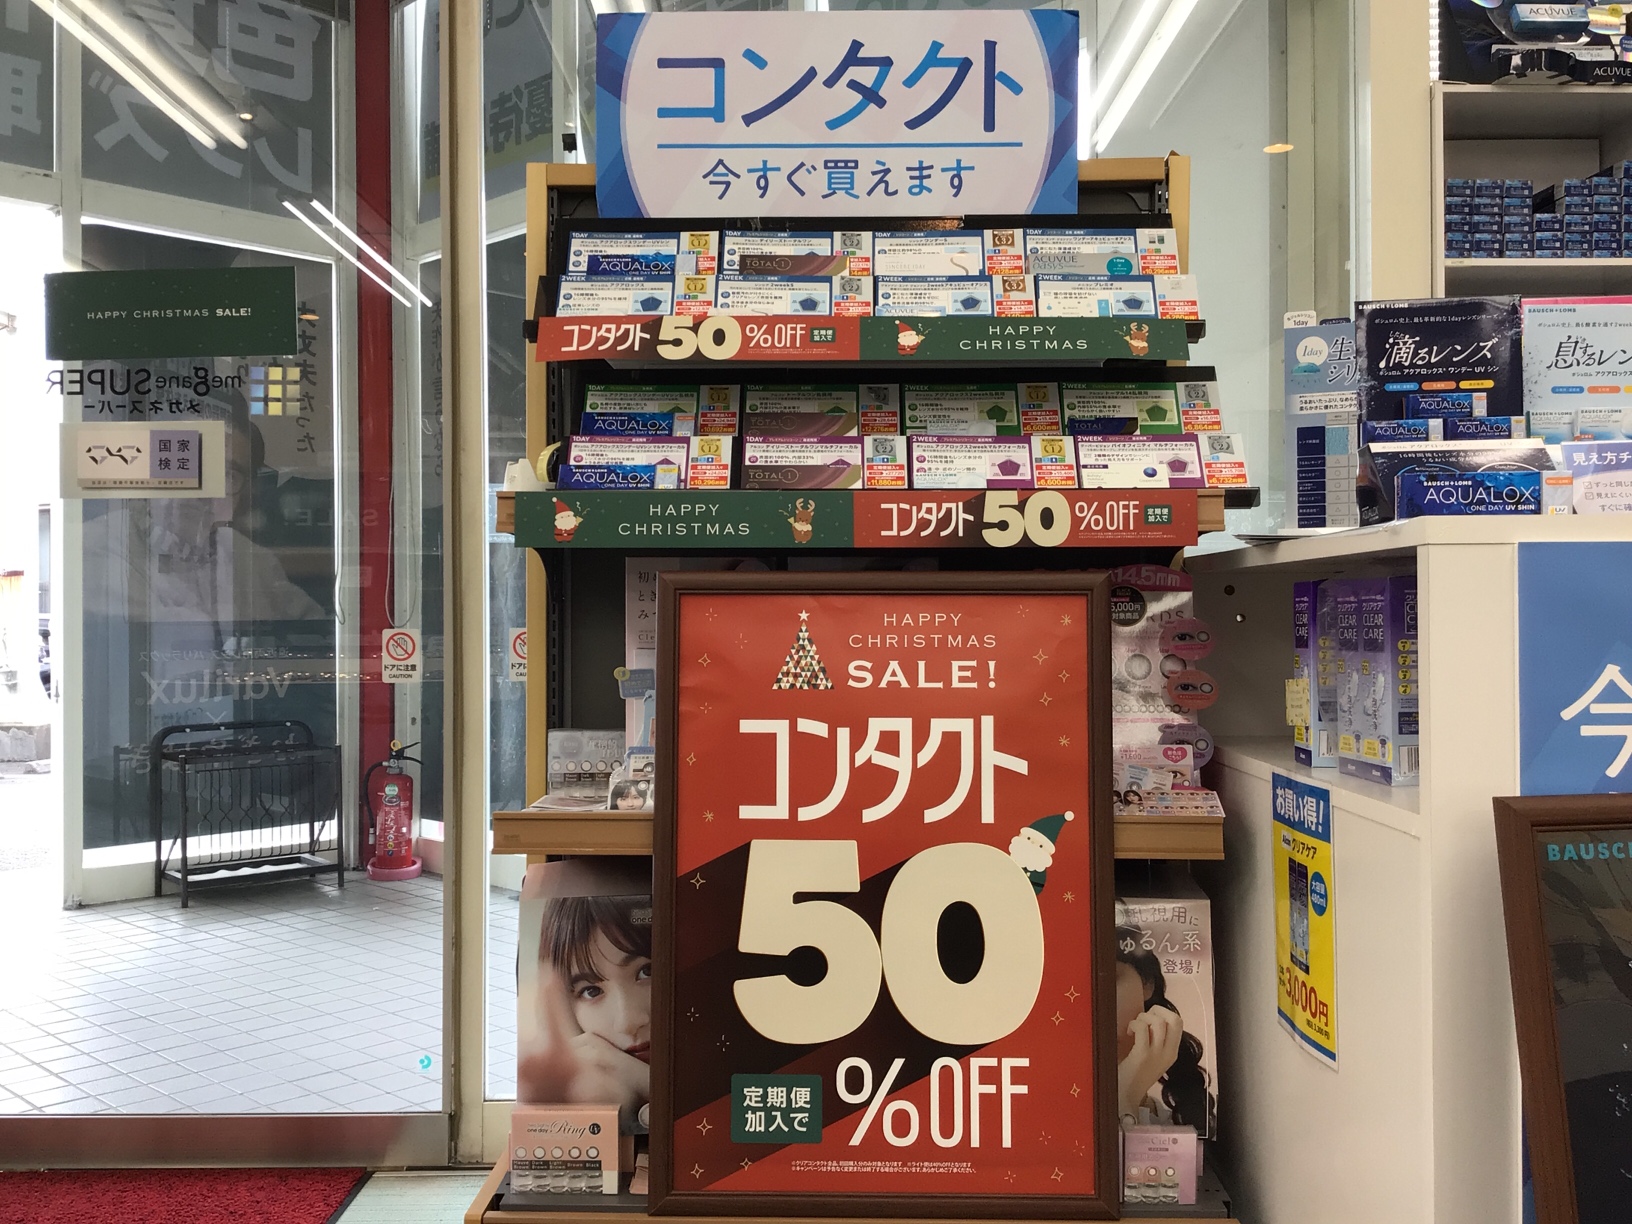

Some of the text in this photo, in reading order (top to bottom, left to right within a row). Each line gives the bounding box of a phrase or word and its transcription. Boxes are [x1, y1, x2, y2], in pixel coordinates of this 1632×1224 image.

[1529, 7, 1578, 16] ACUVUE
[1593, 66, 1632, 76] ACUVUE
[657, 39, 1023, 132] コンタクト
[702, 158, 976, 199] 今すぐ買えます
[1032, 255, 1078, 263] ACUVUE
[598, 261, 673, 271] AQUALOX
[87, 307, 252, 319] HAPPY CHRISTMAS SALE!
[989, 325, 1057, 336] HAPPY
[561, 315, 806, 360] コンタクト 50 %OFF
[959, 339, 1088, 351] CHRISTMAS
[1302, 345, 1324, 358] 1day
[1378, 335, 1500, 369] 滴るレンズ
[1419, 401, 1470, 409] AQUALOX
[594, 420, 670, 430] AQUALOX
[1375, 426, 1426, 435] AQUALOX
[1457, 424, 1508, 432] AQUALOX
[158, 439, 190, 453] 国家
[157, 457, 190, 470] 検定
[1572, 451, 1632, 465] 見え方チ
[571, 472, 651, 482] AQUALOX
[749, 472, 783, 480] TOTAL
[1424, 486, 1535, 504] AQUALOX
[650, 504, 720, 517] HAPPY
[881, 491, 1140, 548] コンタクト 50 %OFF
[1146, 515, 1170, 523] 加入で
[618, 522, 751, 536] CHRISTMAS
[884, 613, 962, 626] HAPPY
[1295, 613, 1308, 625] CLEAR
[1338, 614, 1357, 626] CLEAR
[1362, 613, 1384, 626] CLEAR
[1295, 626, 1308, 637] CARE
[1338, 628, 1358, 640] CARE
[1363, 628, 1384, 640] CARE
[848, 634, 997, 648] CHRISTMAS
[384, 664, 417, 672] ドアに注意
[847, 660, 997, 689] SALE!
[1560, 663, 1632, 778] 今
[739, 715, 1029, 824] コンタクト
[1275, 786, 1323, 833] お買い得!
[1291, 838, 1317, 859] クリアケア
[1128, 905, 1200, 926] 乱視用に
[733, 839, 1045, 1045] 50
[1163, 958, 1201, 975] 登場!
[1286, 966, 1329, 1028] 3,000円
[743, 1086, 812, 1109] 定期便
[834, 1056, 1031, 1150] %OFF
[744, 1111, 812, 1134] 加入で
[550, 1120, 587, 1140] Ring
